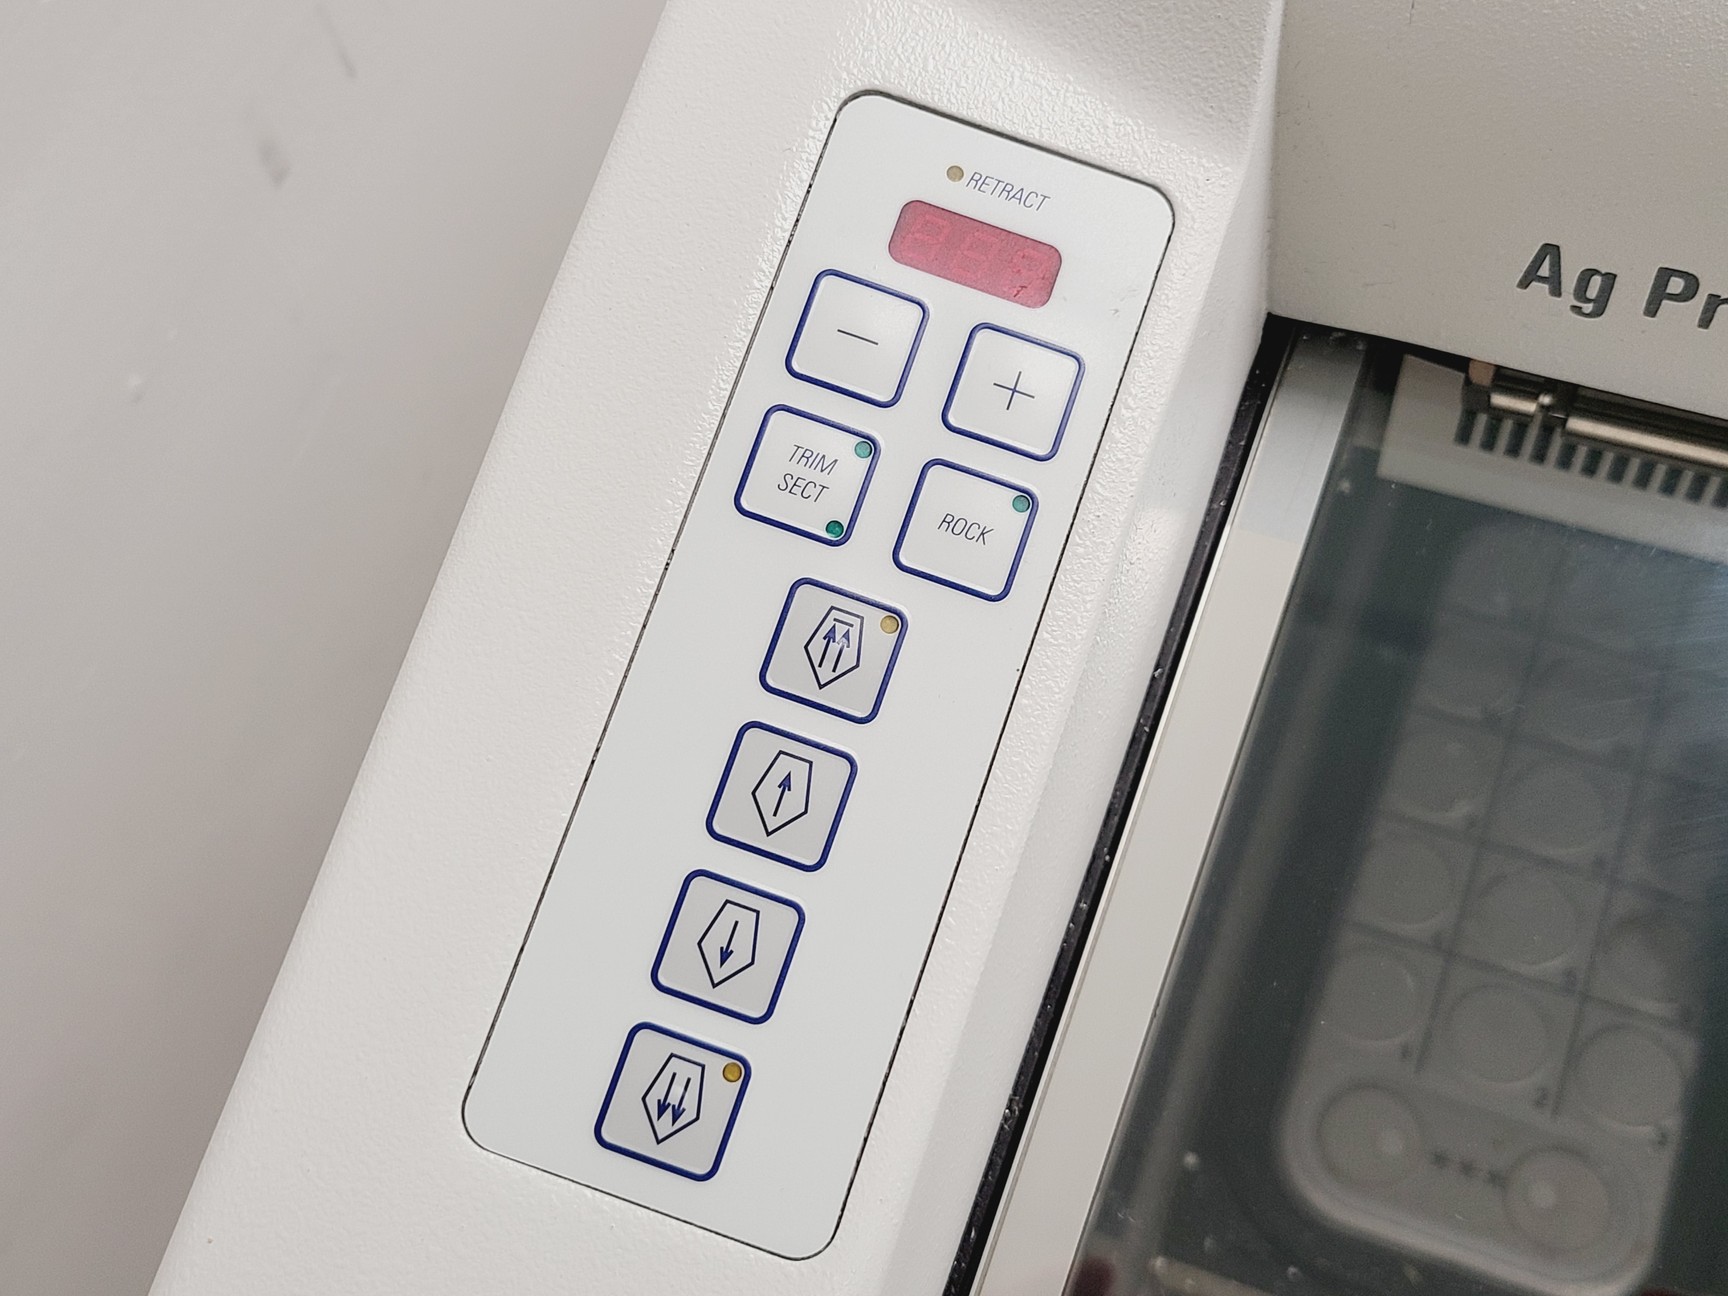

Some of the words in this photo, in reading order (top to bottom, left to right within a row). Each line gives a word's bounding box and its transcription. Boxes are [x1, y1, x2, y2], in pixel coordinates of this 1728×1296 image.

[966, 171, 1051, 212] RETRACT
[1515, 242, 1618, 319] Ag
[1642, 266, 1728, 330] Pr
[788, 444, 839, 476] TRIM
[777, 473, 830, 503] SECT
[937, 513, 995, 546] ROCK
